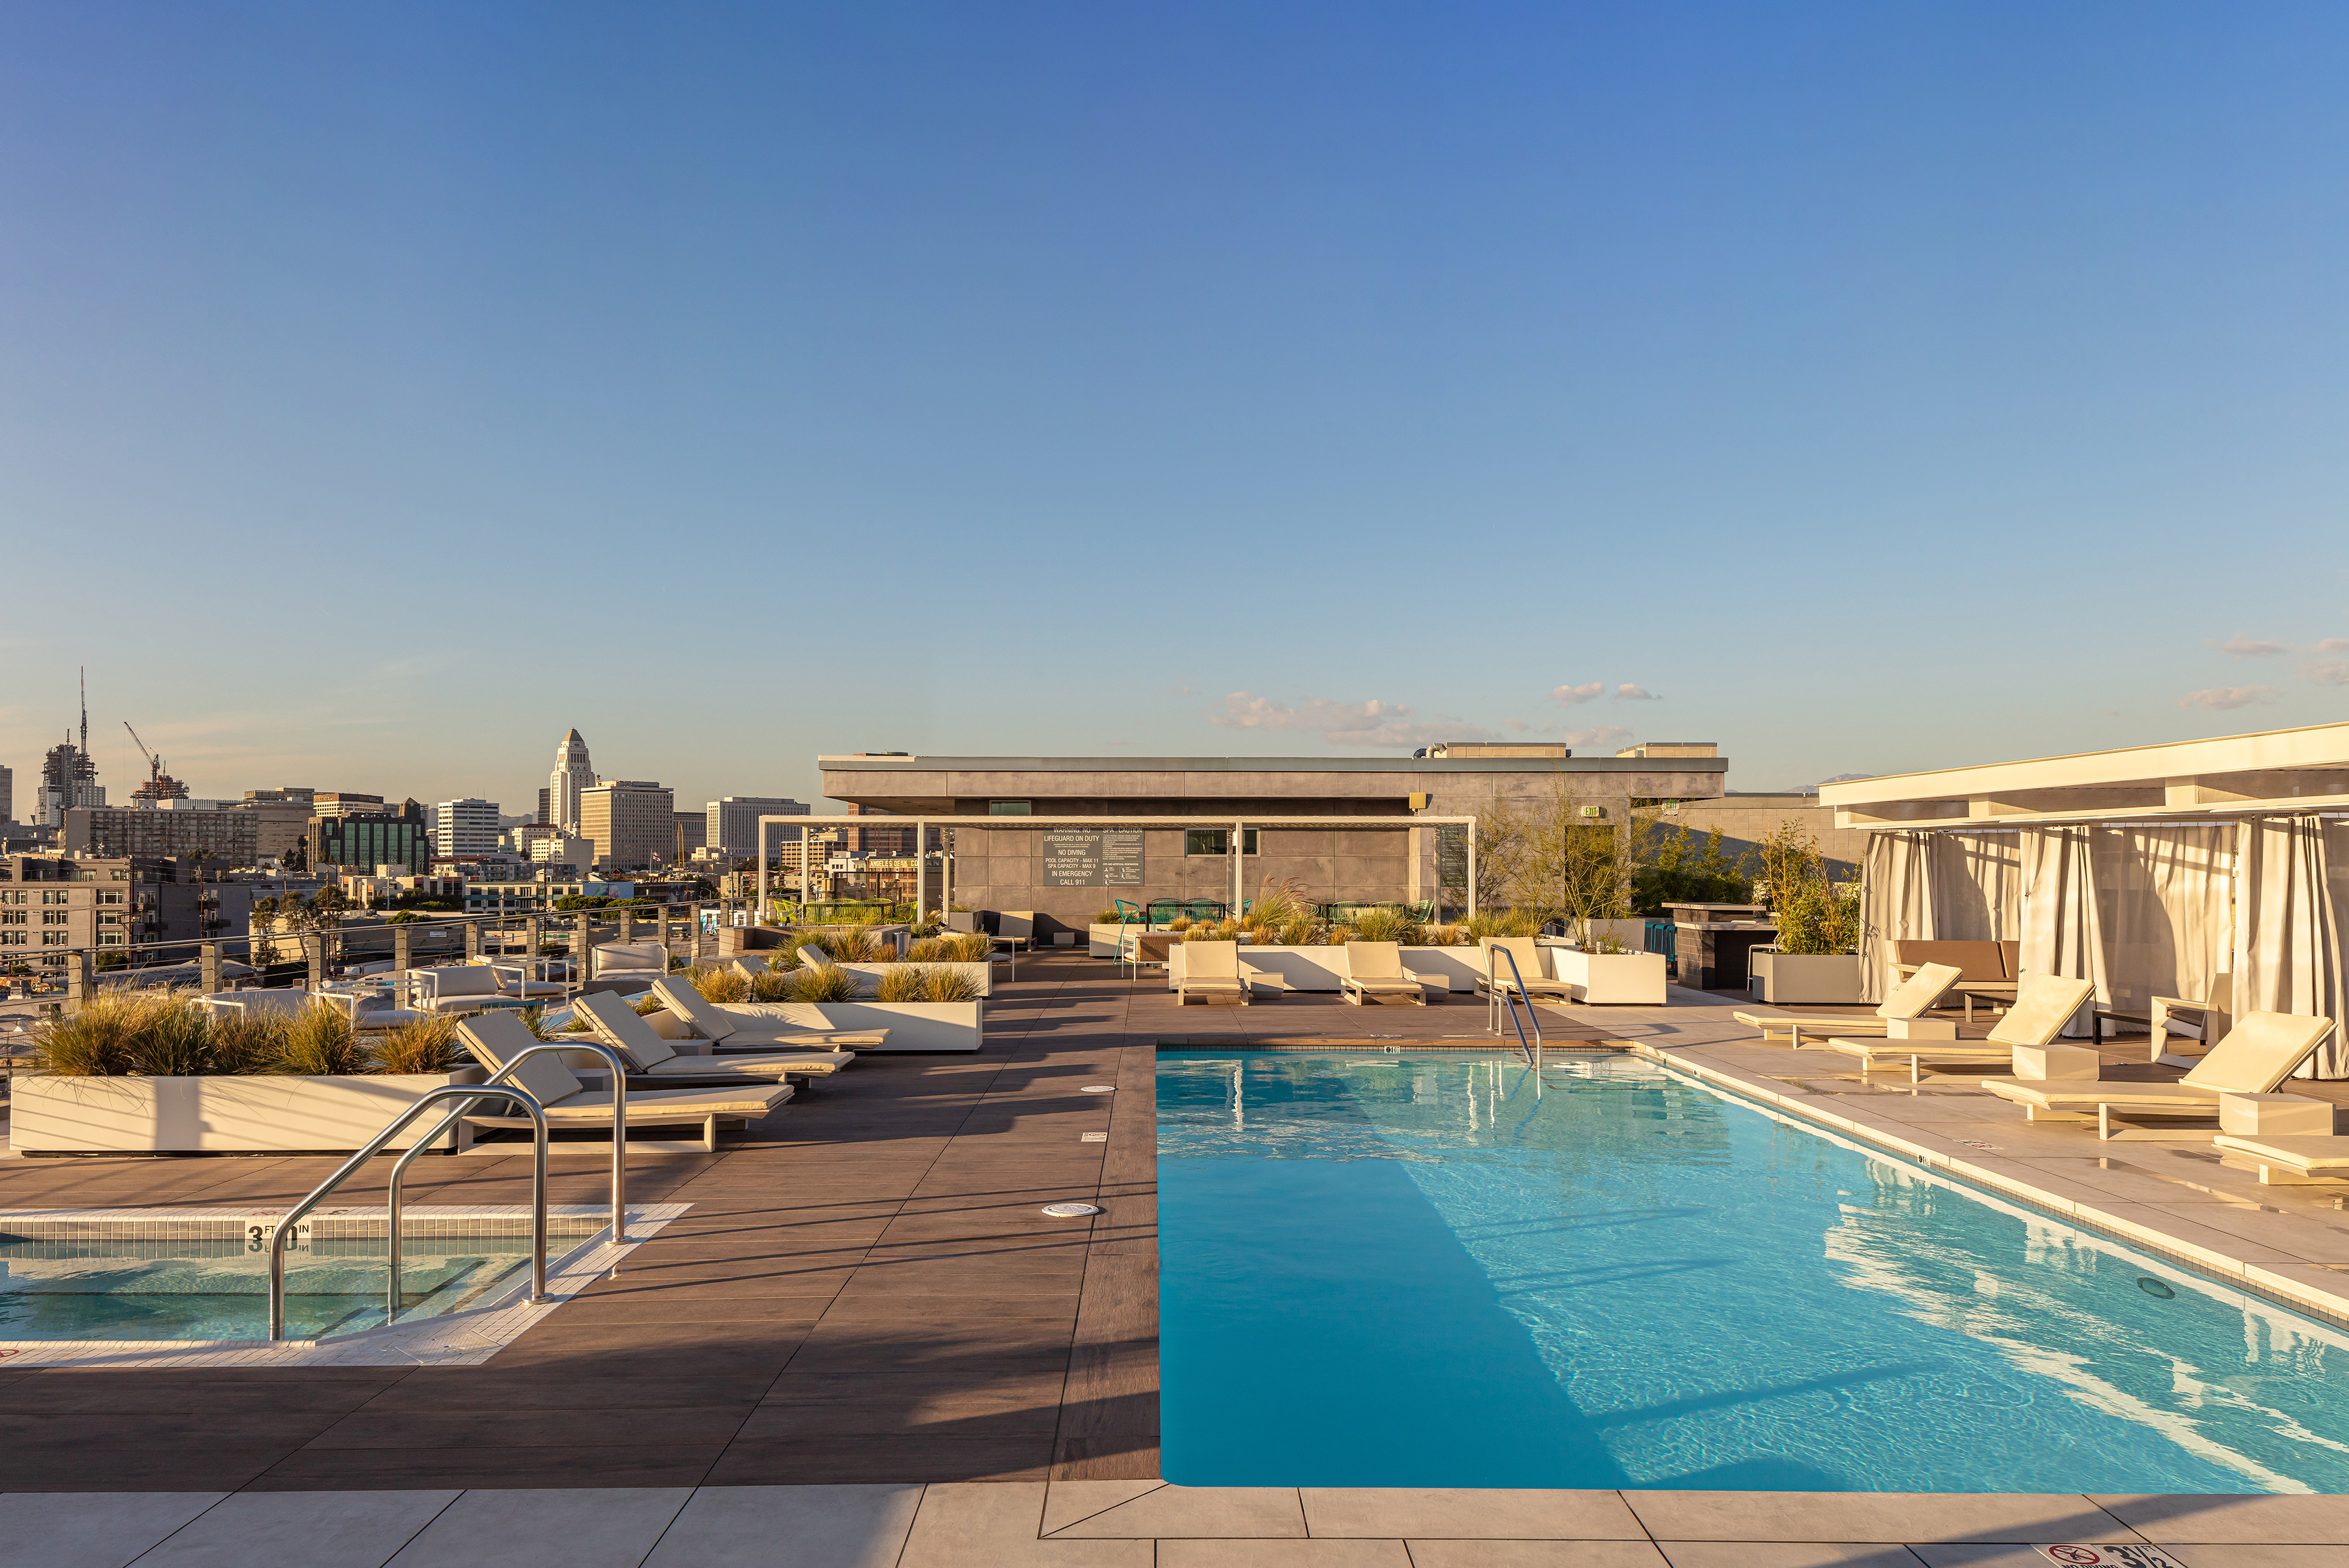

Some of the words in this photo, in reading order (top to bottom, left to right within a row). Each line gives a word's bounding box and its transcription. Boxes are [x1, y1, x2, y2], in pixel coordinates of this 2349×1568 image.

[1666, 800, 1678, 809] EXIT
[1585, 807, 1597, 816] EXIT
[249, 1225, 263, 1242] 3
